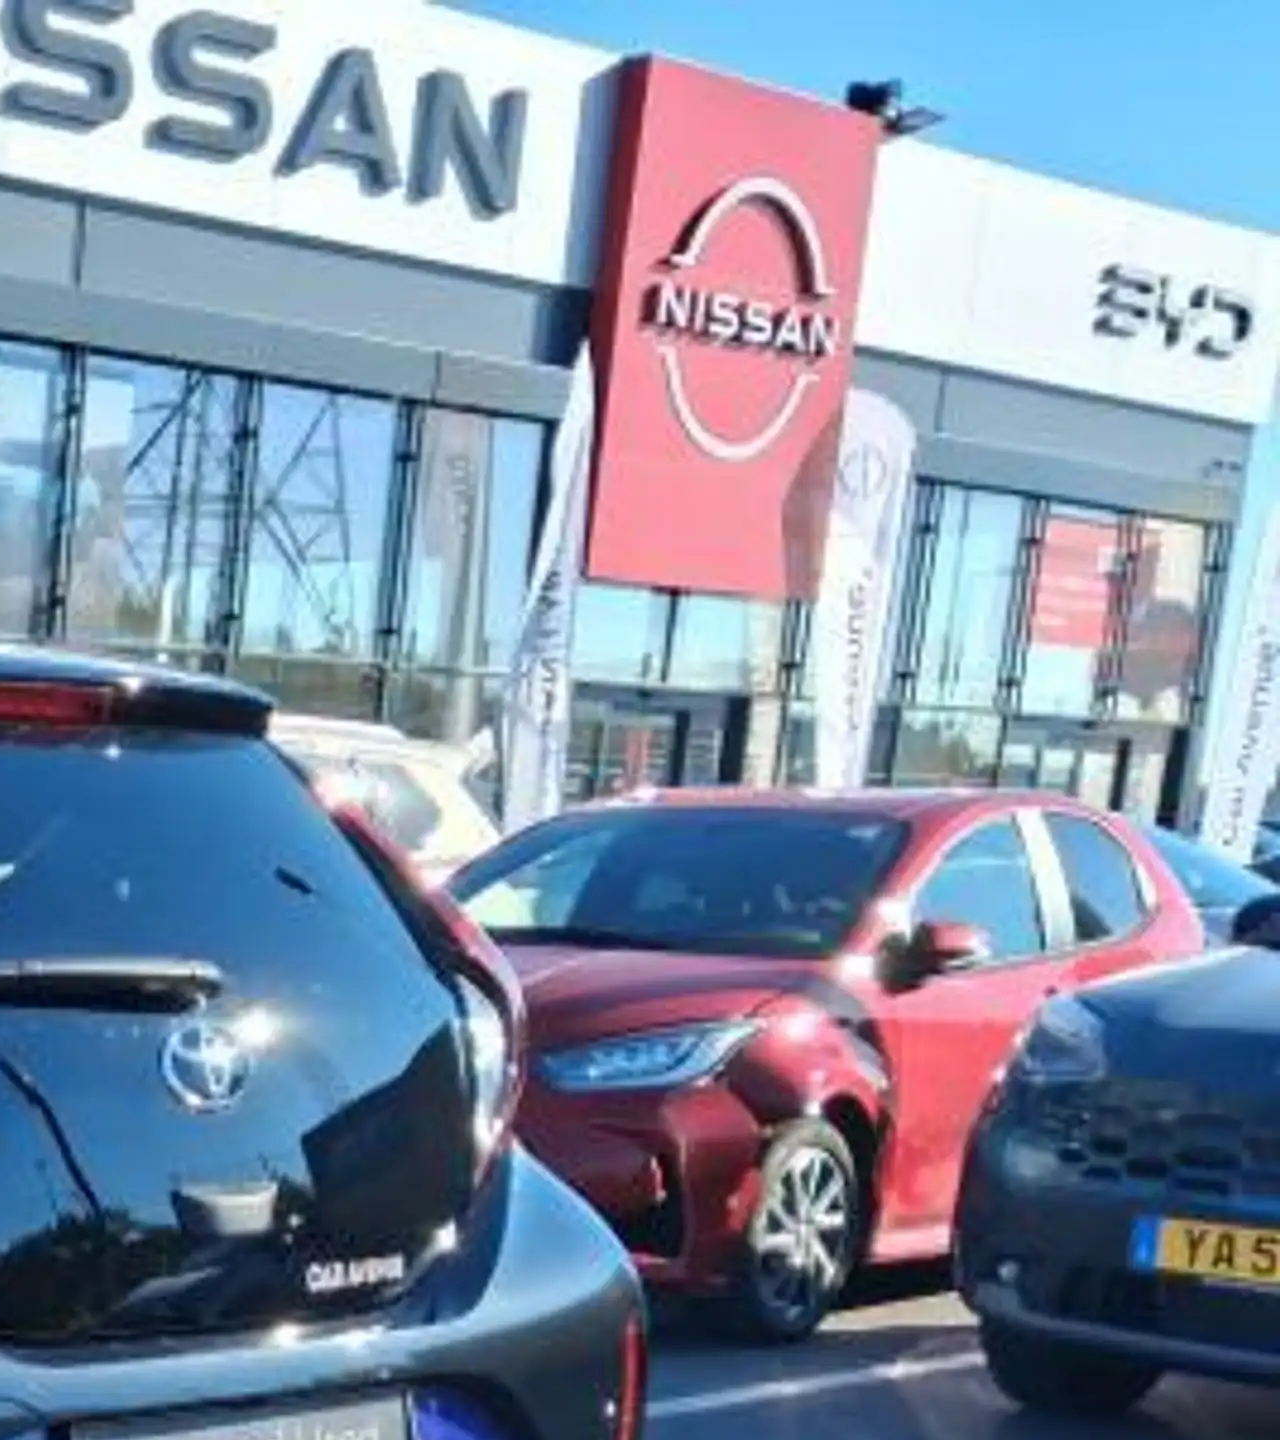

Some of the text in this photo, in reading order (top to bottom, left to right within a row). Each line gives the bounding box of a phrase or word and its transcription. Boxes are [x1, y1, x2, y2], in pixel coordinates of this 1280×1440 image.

[655, 278, 841, 360] NISSAN
[1092, 262, 1253, 361] BYD
[1184, 1228, 1279, 1276] YA 5
